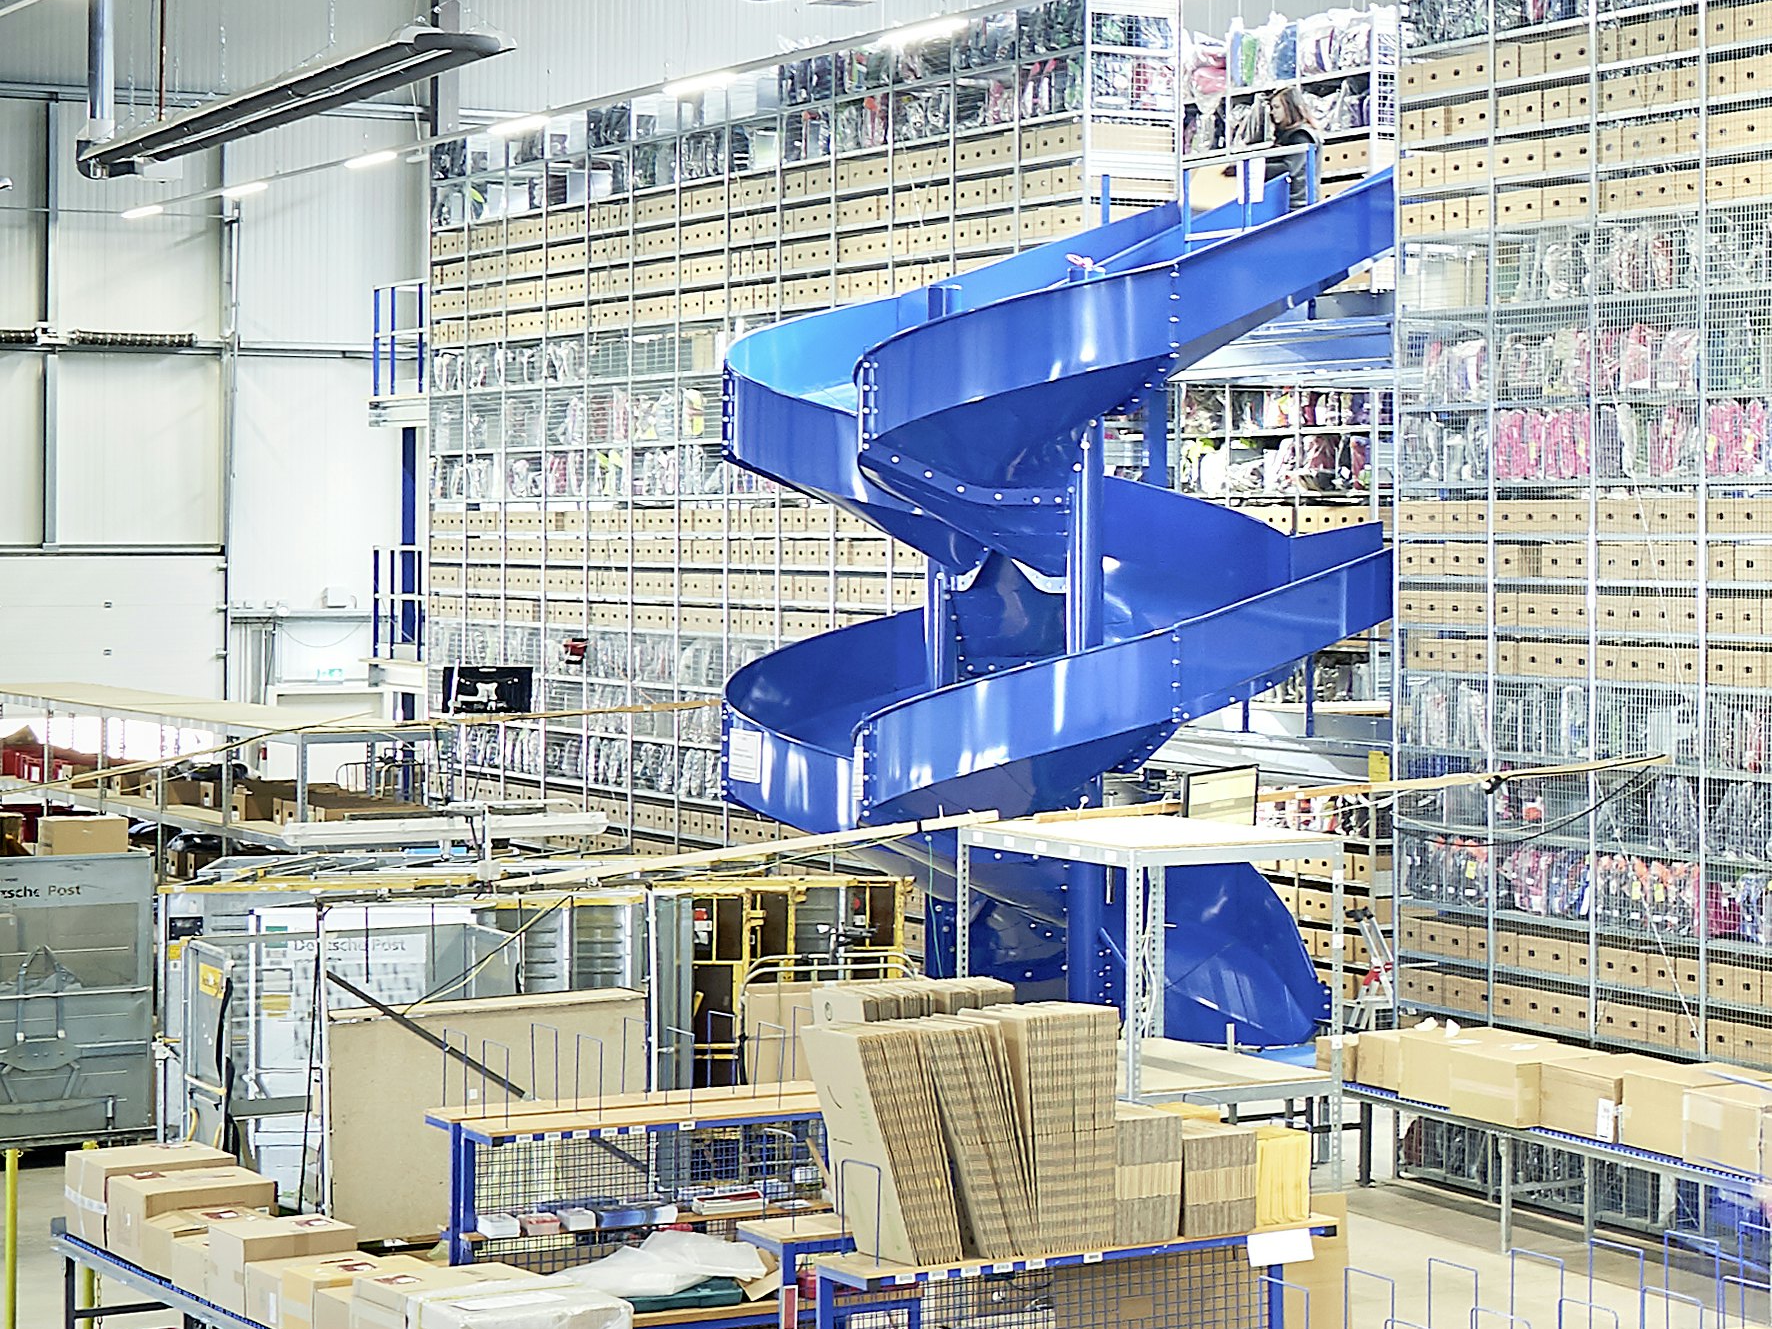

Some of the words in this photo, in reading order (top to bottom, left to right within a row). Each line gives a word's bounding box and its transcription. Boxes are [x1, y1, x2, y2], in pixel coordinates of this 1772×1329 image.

[48, 884, 82, 897] Post
[293, 938, 370, 953] Detsche
[372, 938, 407, 952] Post
